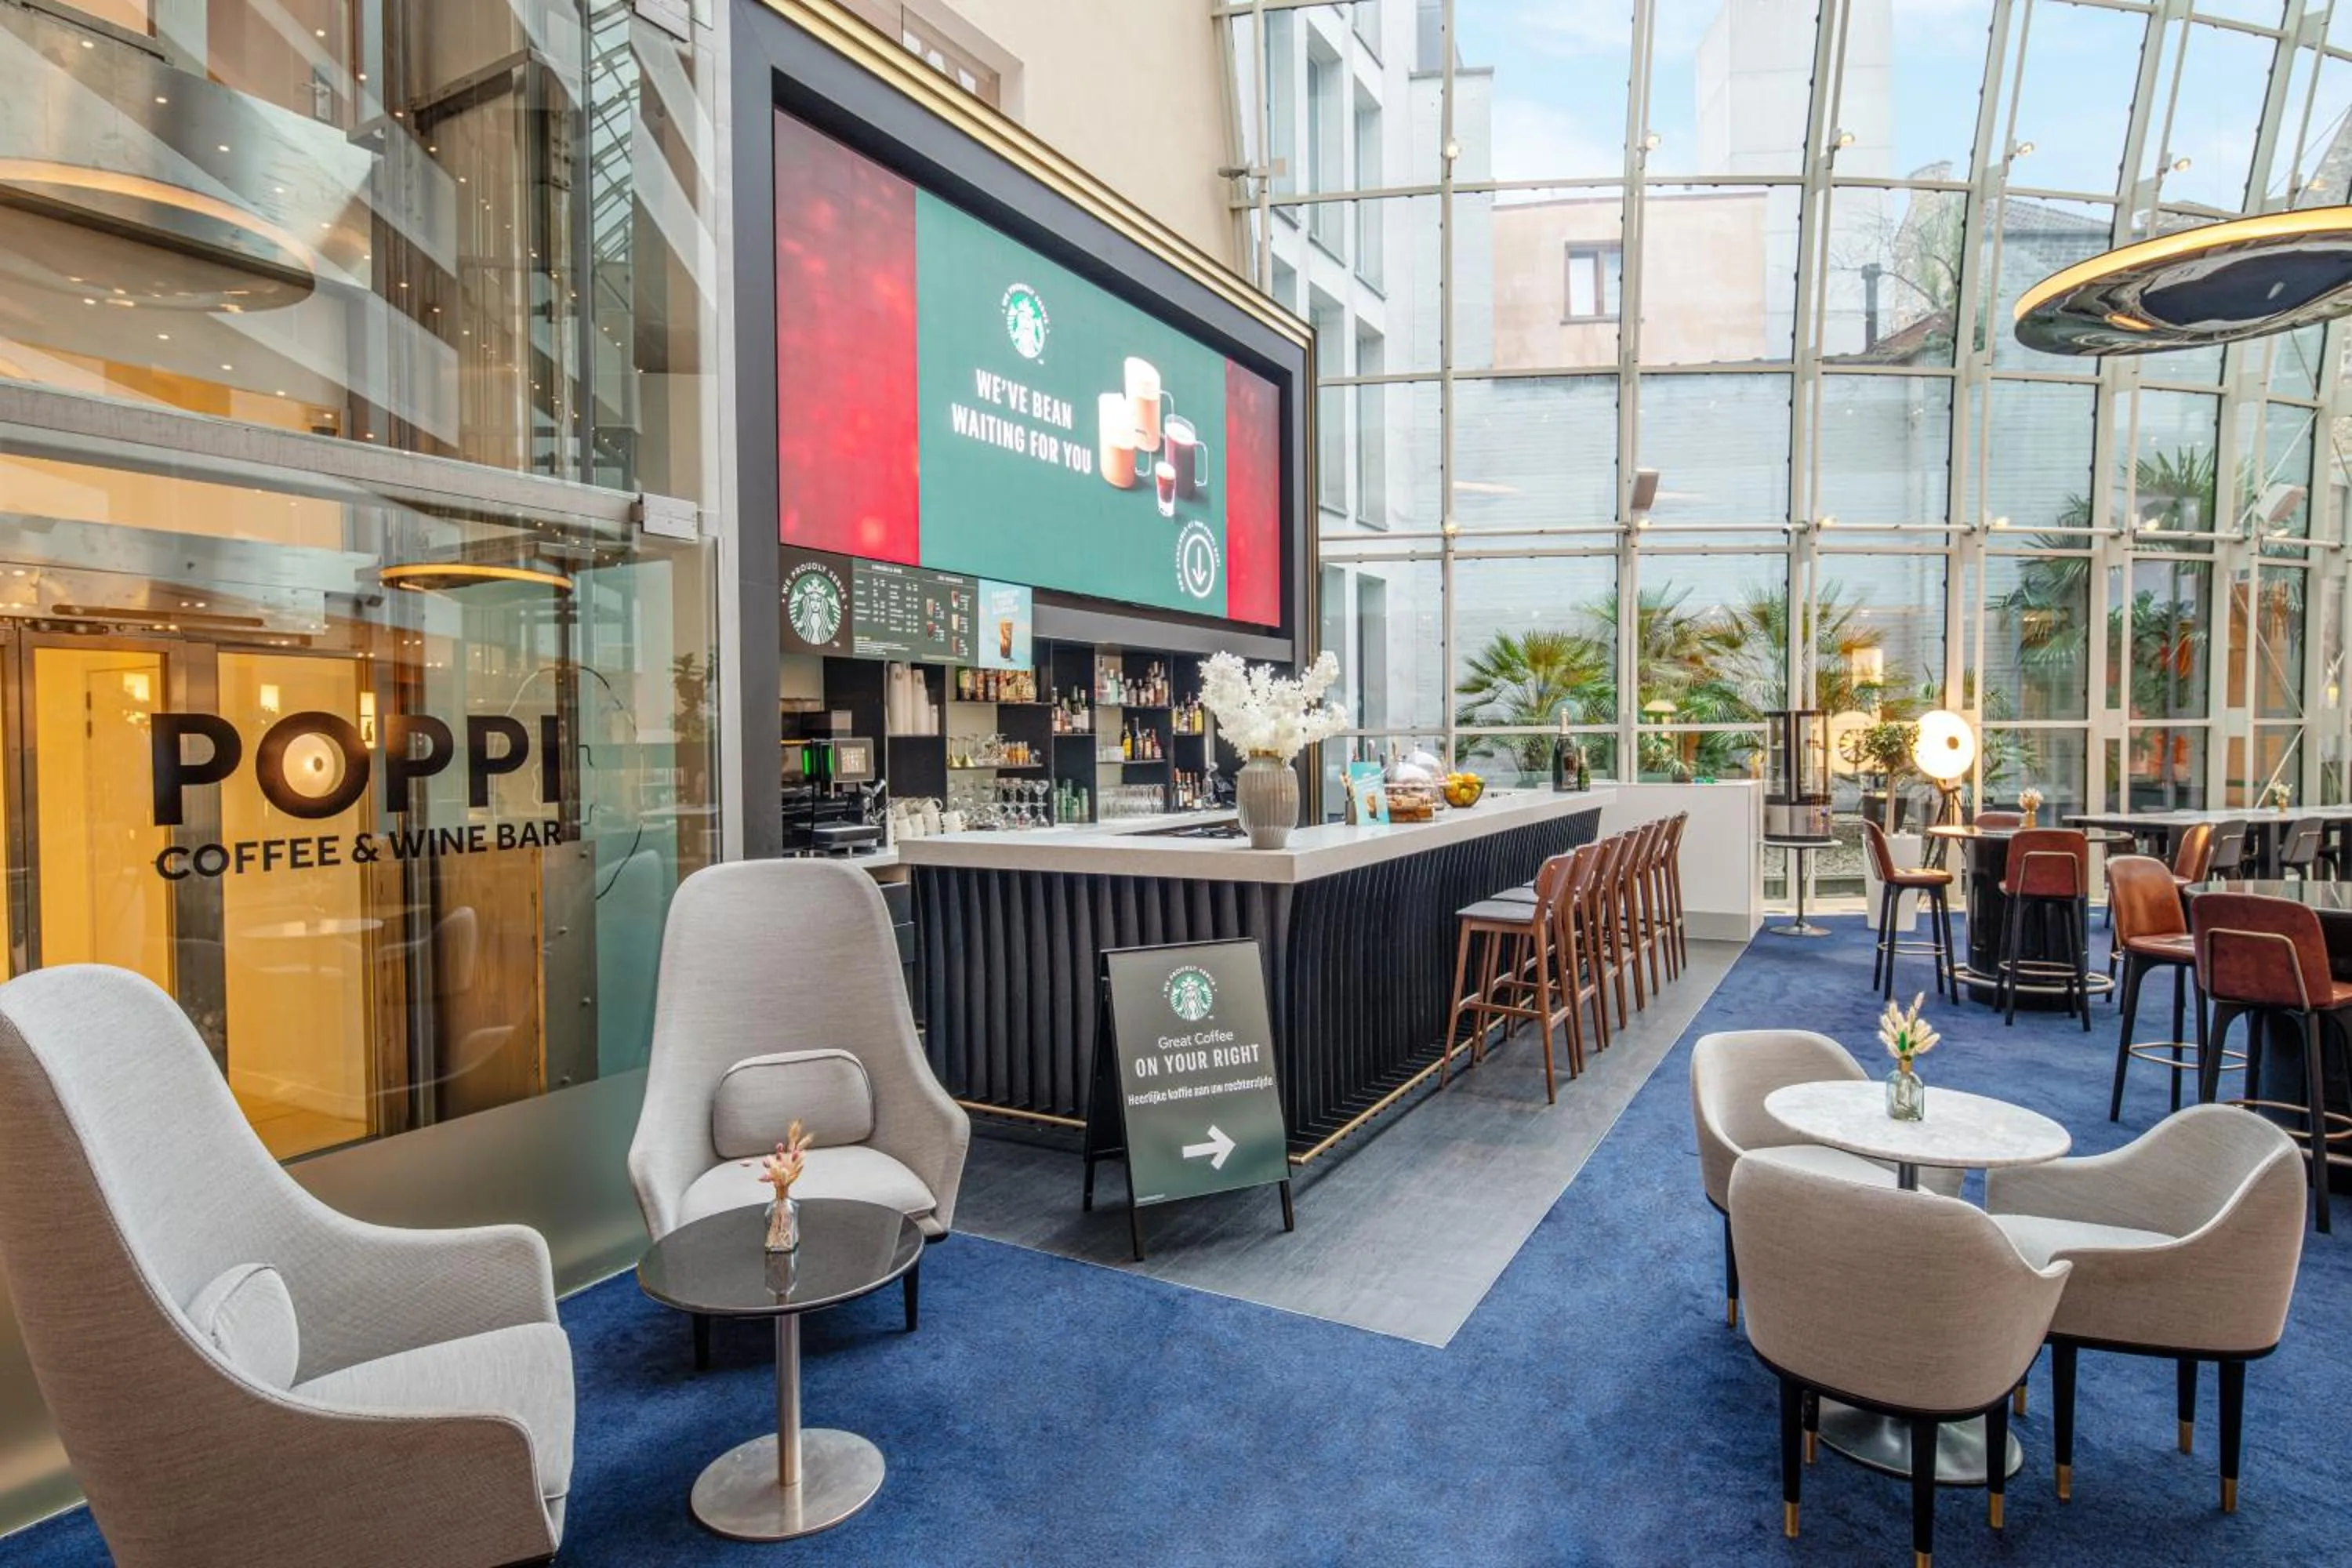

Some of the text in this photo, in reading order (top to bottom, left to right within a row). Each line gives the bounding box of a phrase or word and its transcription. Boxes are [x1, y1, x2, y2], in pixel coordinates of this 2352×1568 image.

[976, 368, 1072, 430] WE'VE BEAN
[951, 402, 1091, 474] WAITING FOR YOU
[790, 562, 827, 579] PROUDLY
[828, 571, 848, 600] SERVE
[151, 710, 561, 826] POPPI
[156, 820, 562, 880] COFFEE & WINE BAR
[1135, 1044, 1259, 1078] ON YOUR RIGHT
[1158, 1029, 1234, 1050] Great Coffee
[1128, 1076, 1273, 1106] Heerlijke koffie aan uw rechterzijde
